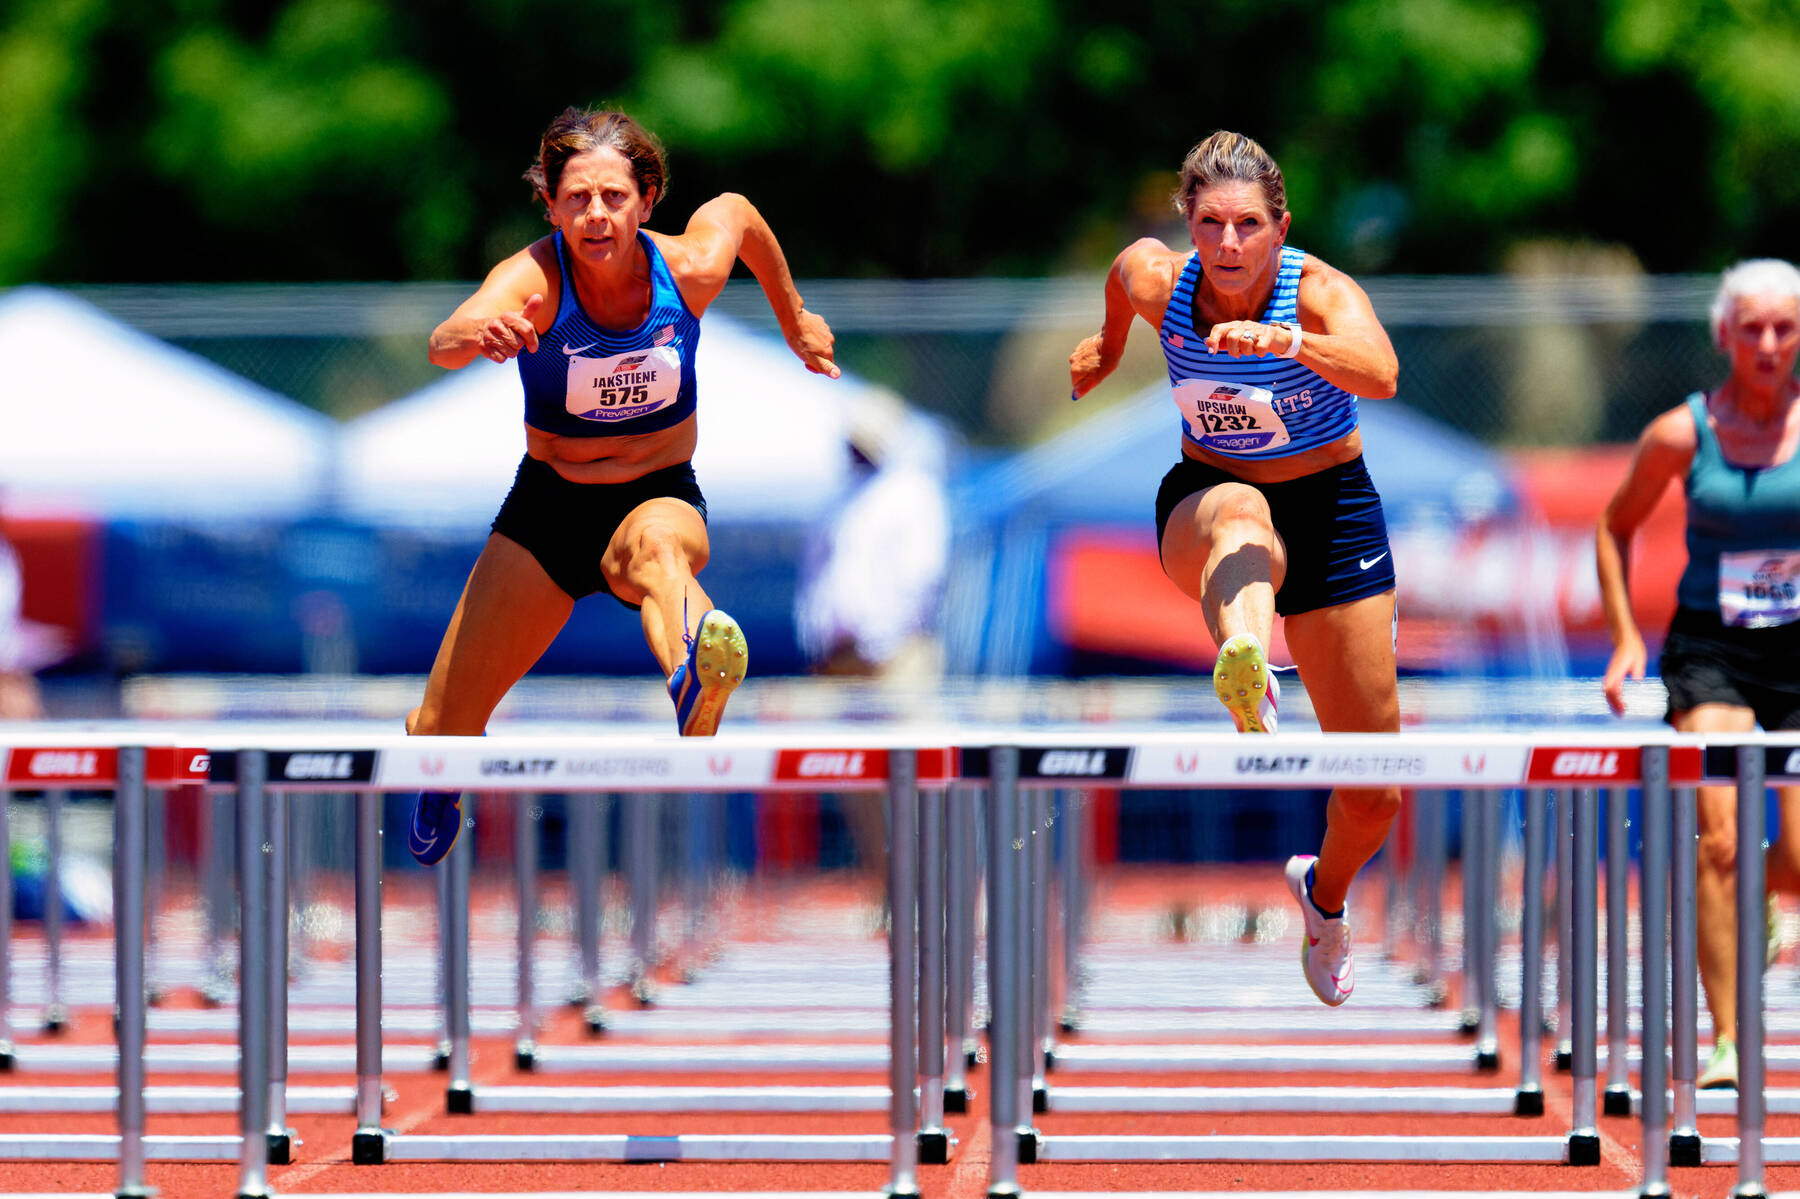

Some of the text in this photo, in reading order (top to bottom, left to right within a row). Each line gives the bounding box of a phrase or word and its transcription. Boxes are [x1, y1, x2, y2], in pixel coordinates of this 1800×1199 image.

[593, 370, 657, 388] JAKSTIENE
[600, 385, 648, 406] 575
[1273, 389, 1313, 416] ITS
[595, 406, 649, 417] Prevagen
[1197, 400, 1247, 415] UPSHAW
[1197, 414, 1262, 433] 1232
[29, 752, 98, 775] GILL
[285, 754, 353, 779] GILL
[480, 759, 557, 776] USATF
[798, 752, 866, 776] GILL
[1038, 750, 1106, 775] GILL
[1235, 756, 1311, 774] USATF
[1552, 751, 1619, 776] GILL
